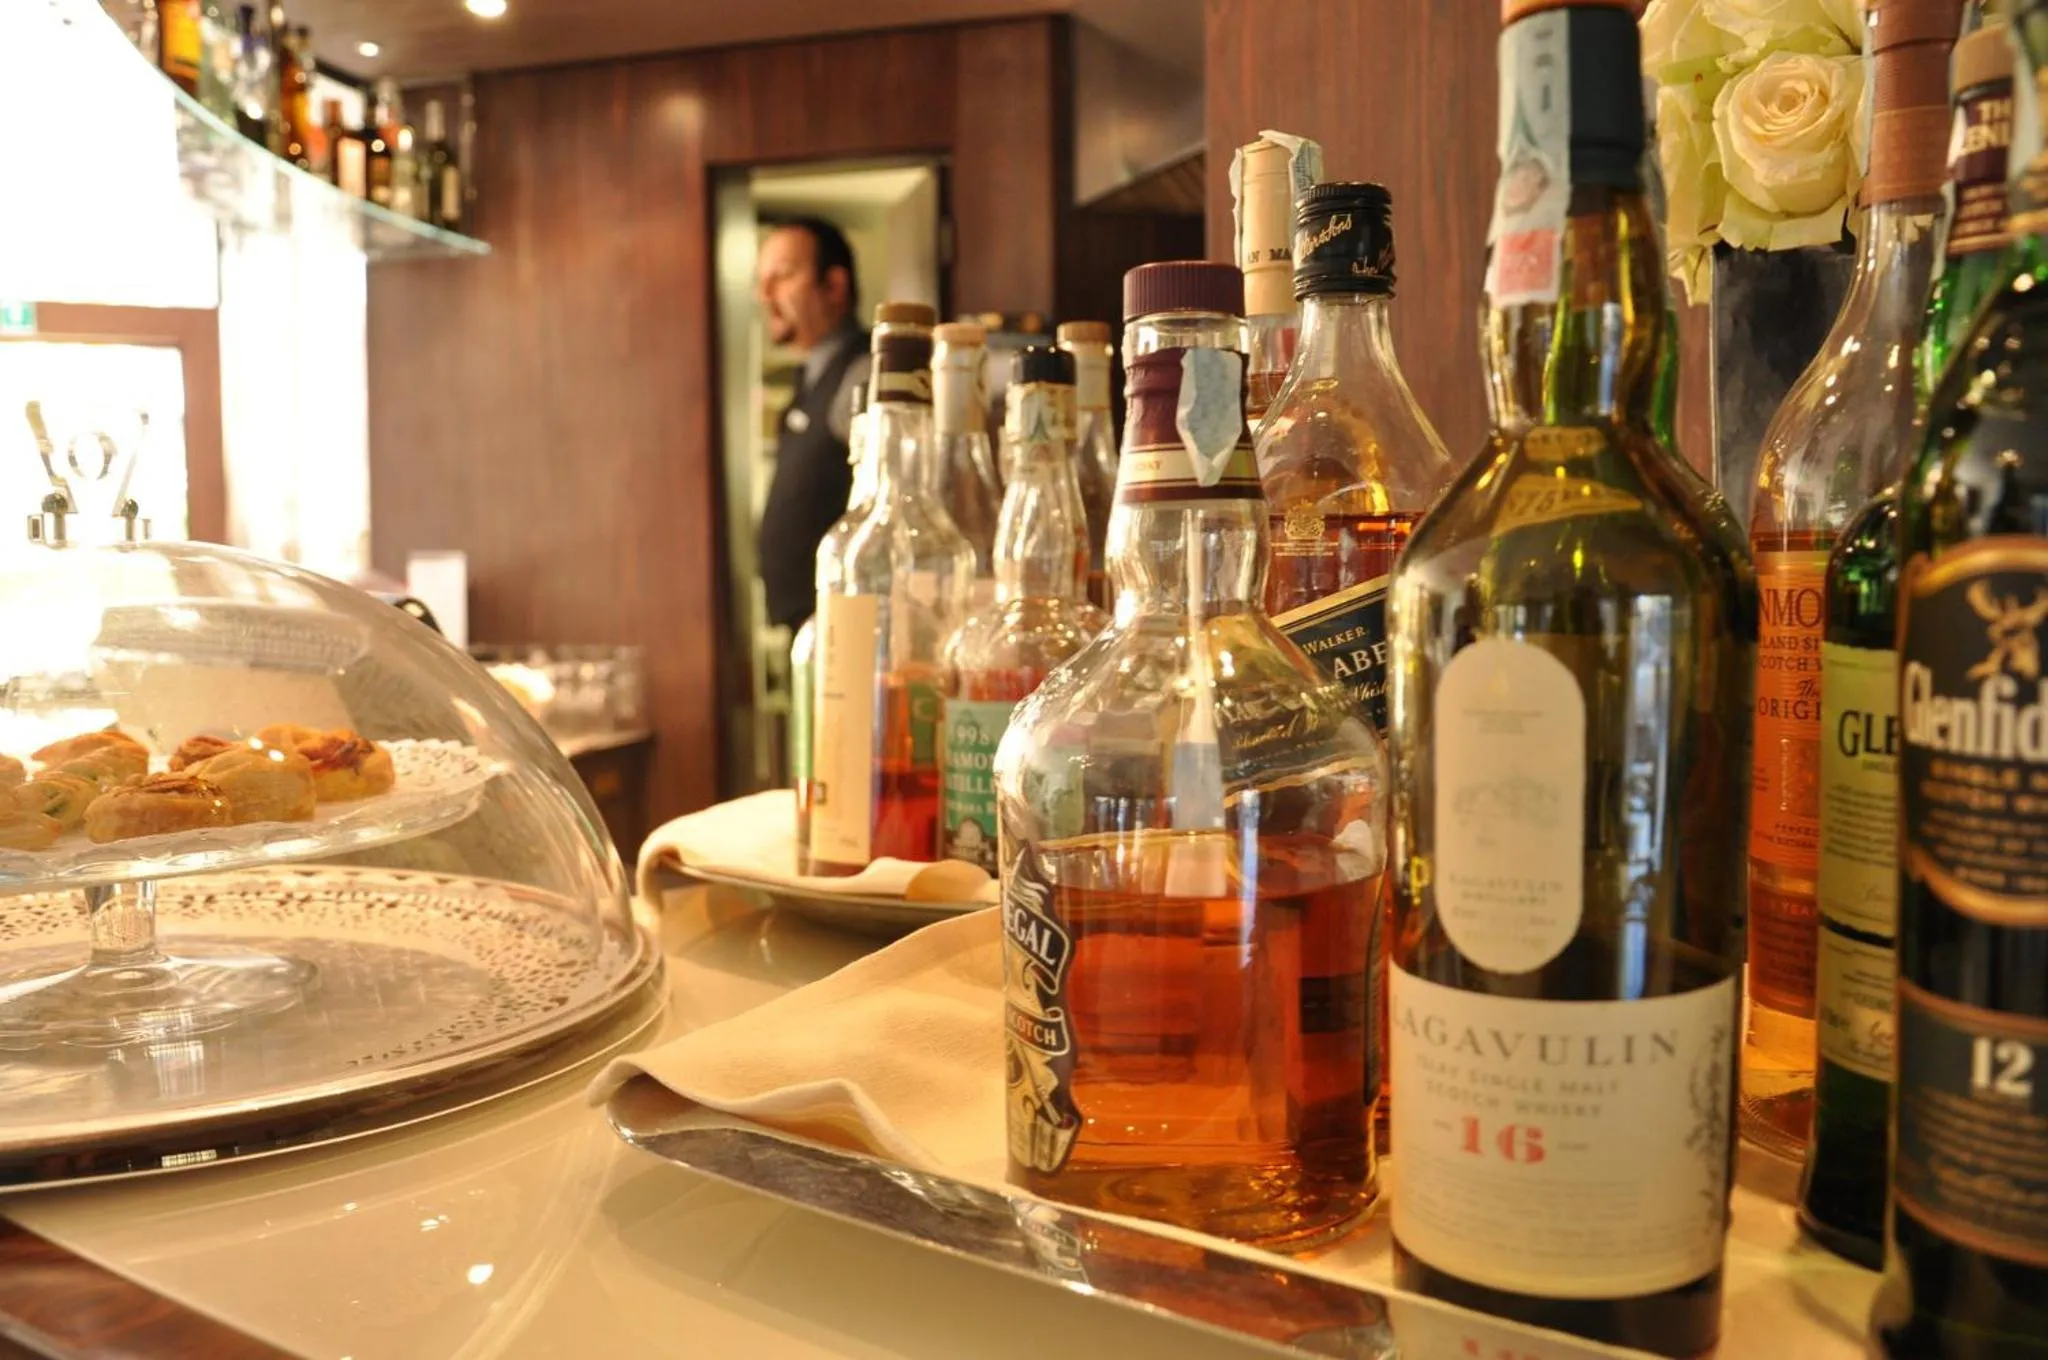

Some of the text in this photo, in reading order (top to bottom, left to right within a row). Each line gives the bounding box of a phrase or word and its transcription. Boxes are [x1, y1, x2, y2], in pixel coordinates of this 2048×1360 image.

[1756, 587, 1822, 628] NMO
[1302, 625, 1367, 656] WALKER
[1333, 641, 1389, 680] ABE
[1763, 635, 1798, 650] LAND
[1904, 660, 2048, 763] Glenfid
[1006, 900, 1057, 967] EGAL
[1391, 994, 1680, 1068] LAGAVULIN
[1468, 1069, 1544, 1095] SINGLE
[1971, 1039, 2035, 1097] 12
[1460, 1114, 1547, 1166] 16
